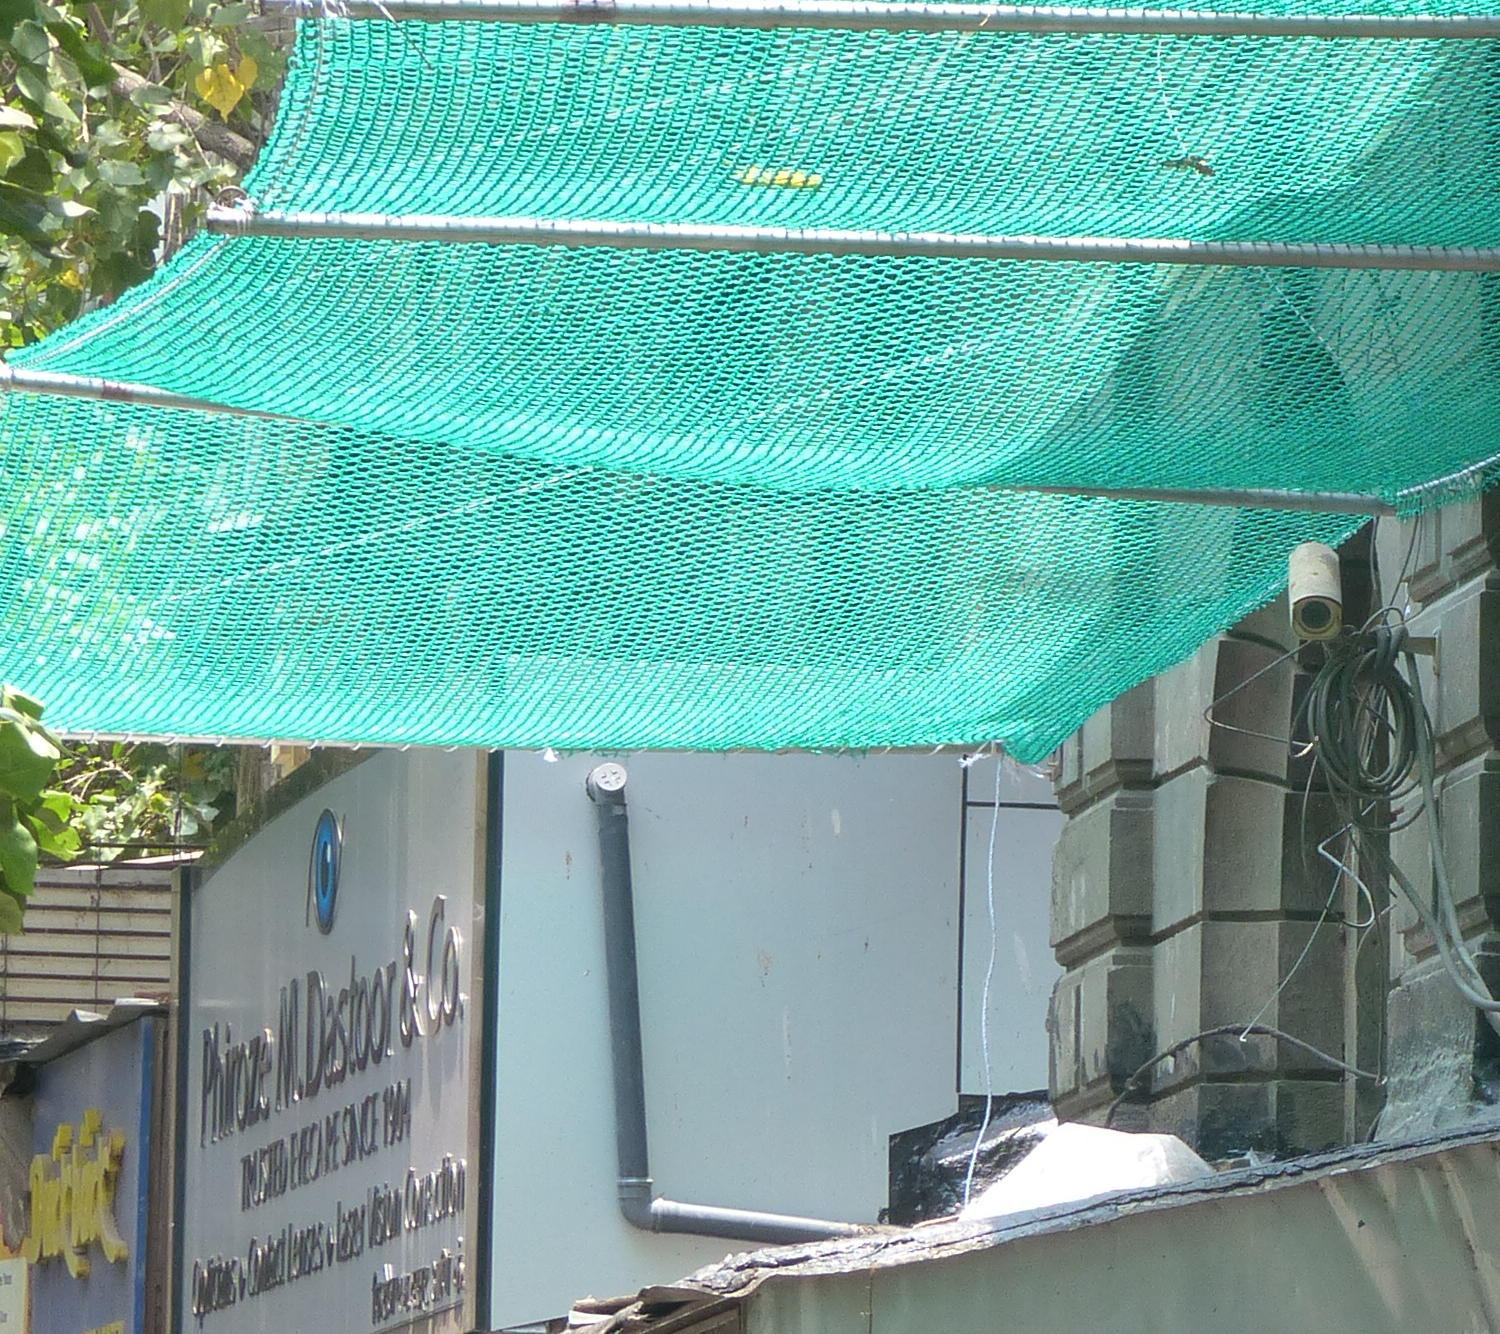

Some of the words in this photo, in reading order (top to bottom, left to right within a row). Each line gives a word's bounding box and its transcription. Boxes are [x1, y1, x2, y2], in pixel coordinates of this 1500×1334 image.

[201, 1021, 273, 1147] Phiroze
[275, 979, 301, 1112] M.
[304, 955, 397, 1098] Dastoor
[401, 908, 425, 1049] &
[425, 894, 466, 1037] Co.
[240, 1132, 289, 1213] TRUSTED
[342, 1091, 380, 1168] SINCE
